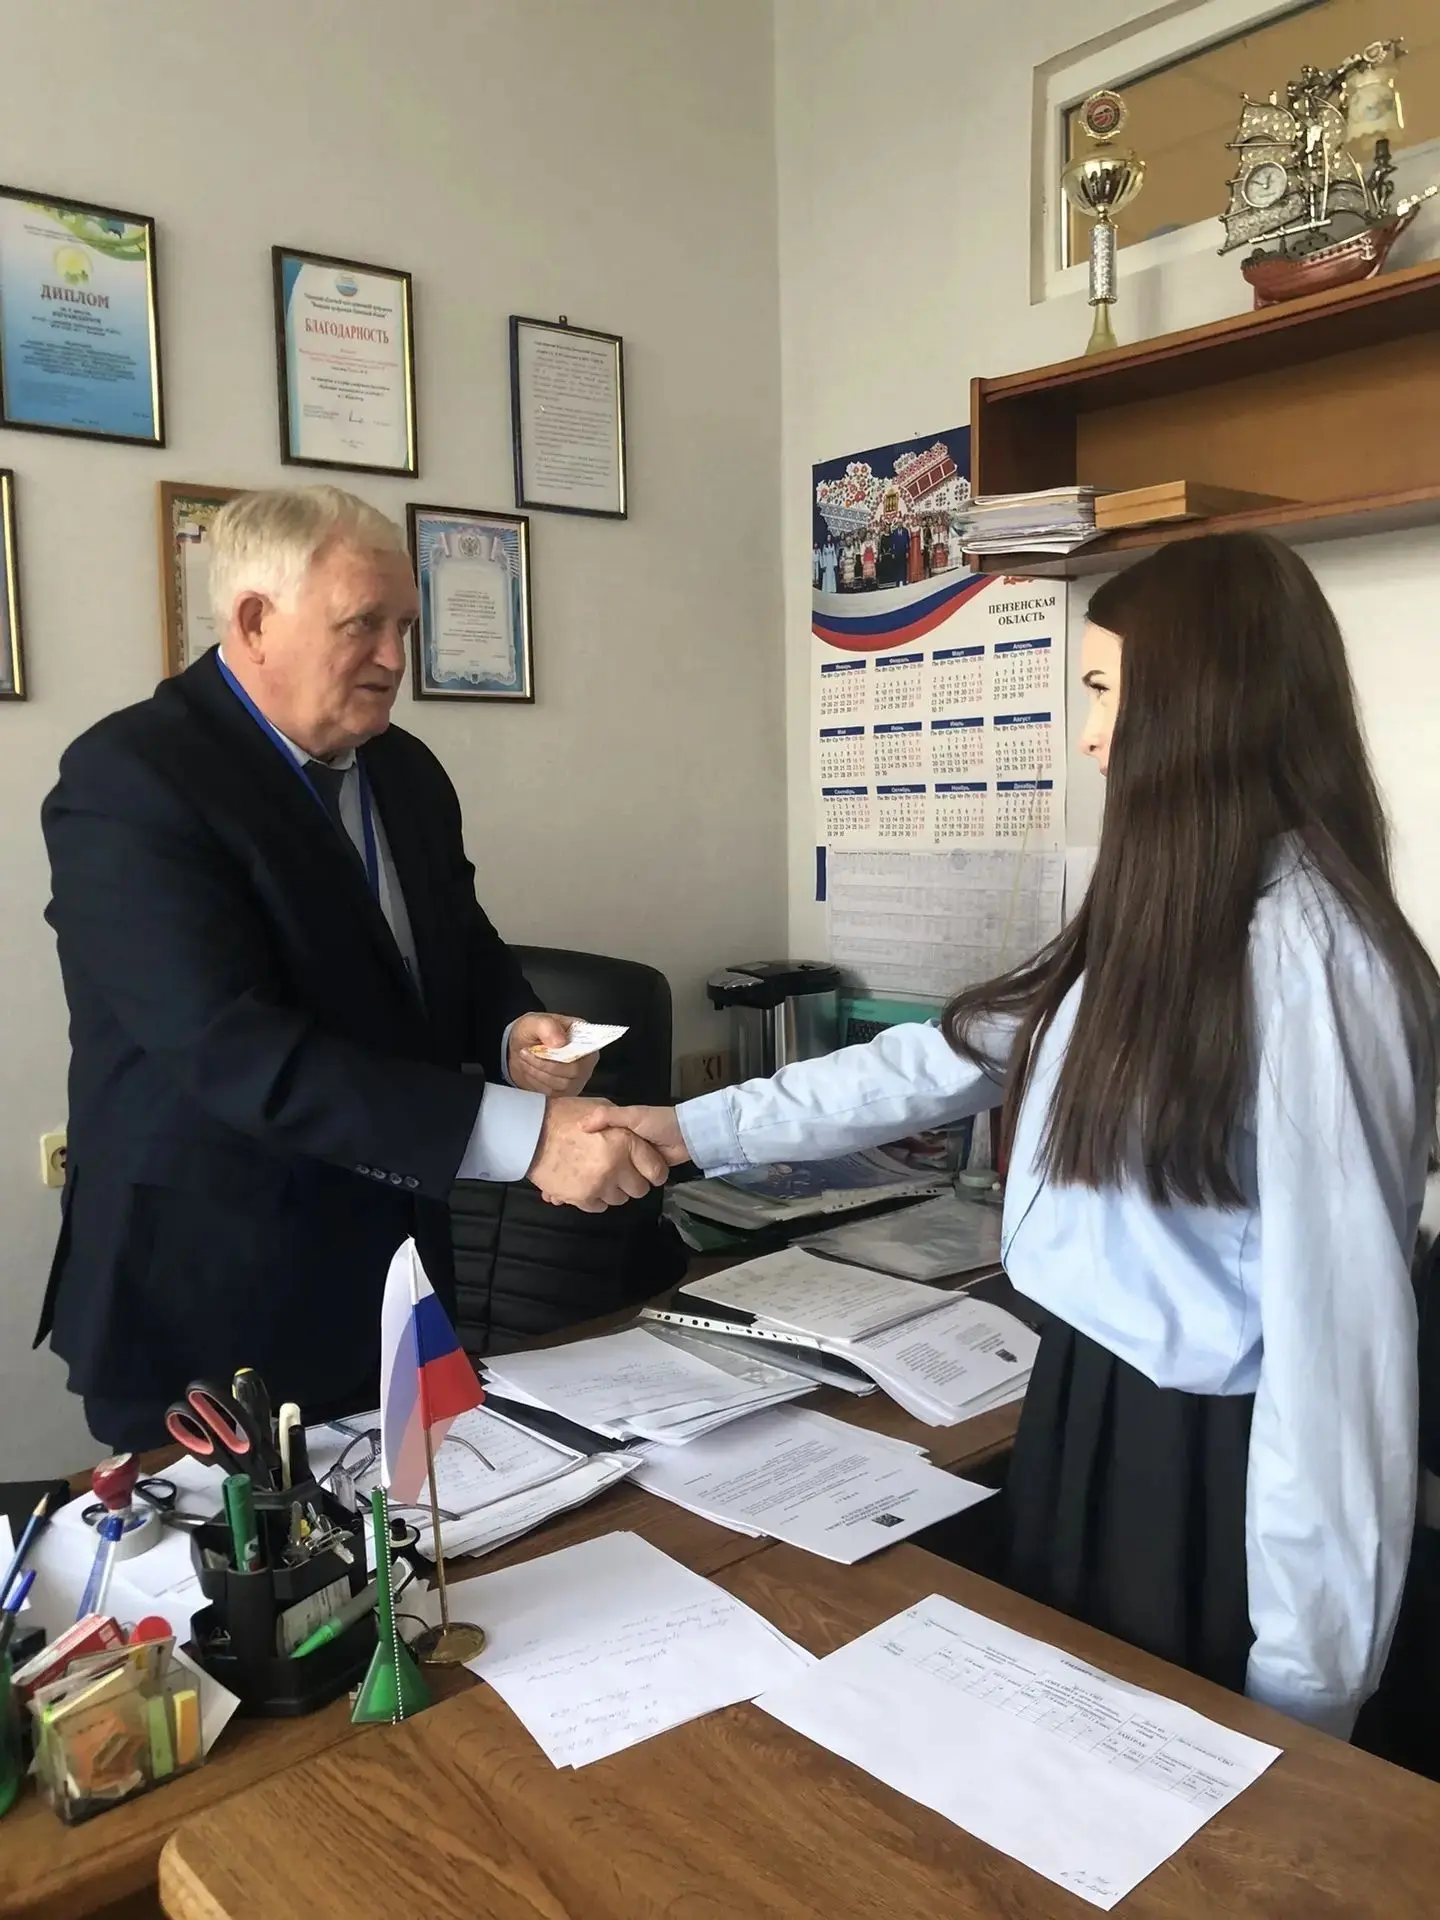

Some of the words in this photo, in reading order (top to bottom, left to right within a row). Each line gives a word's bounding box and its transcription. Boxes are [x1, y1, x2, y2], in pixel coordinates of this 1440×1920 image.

[40, 284, 110, 309] ДИПЛОМ
[305, 318, 389, 344] БЛАГОДАРНОСТЬ
[988, 596, 1056, 614] ПЕНЗЕНСКАЯ
[998, 612, 1045, 626] ОБЛАСТЬ
